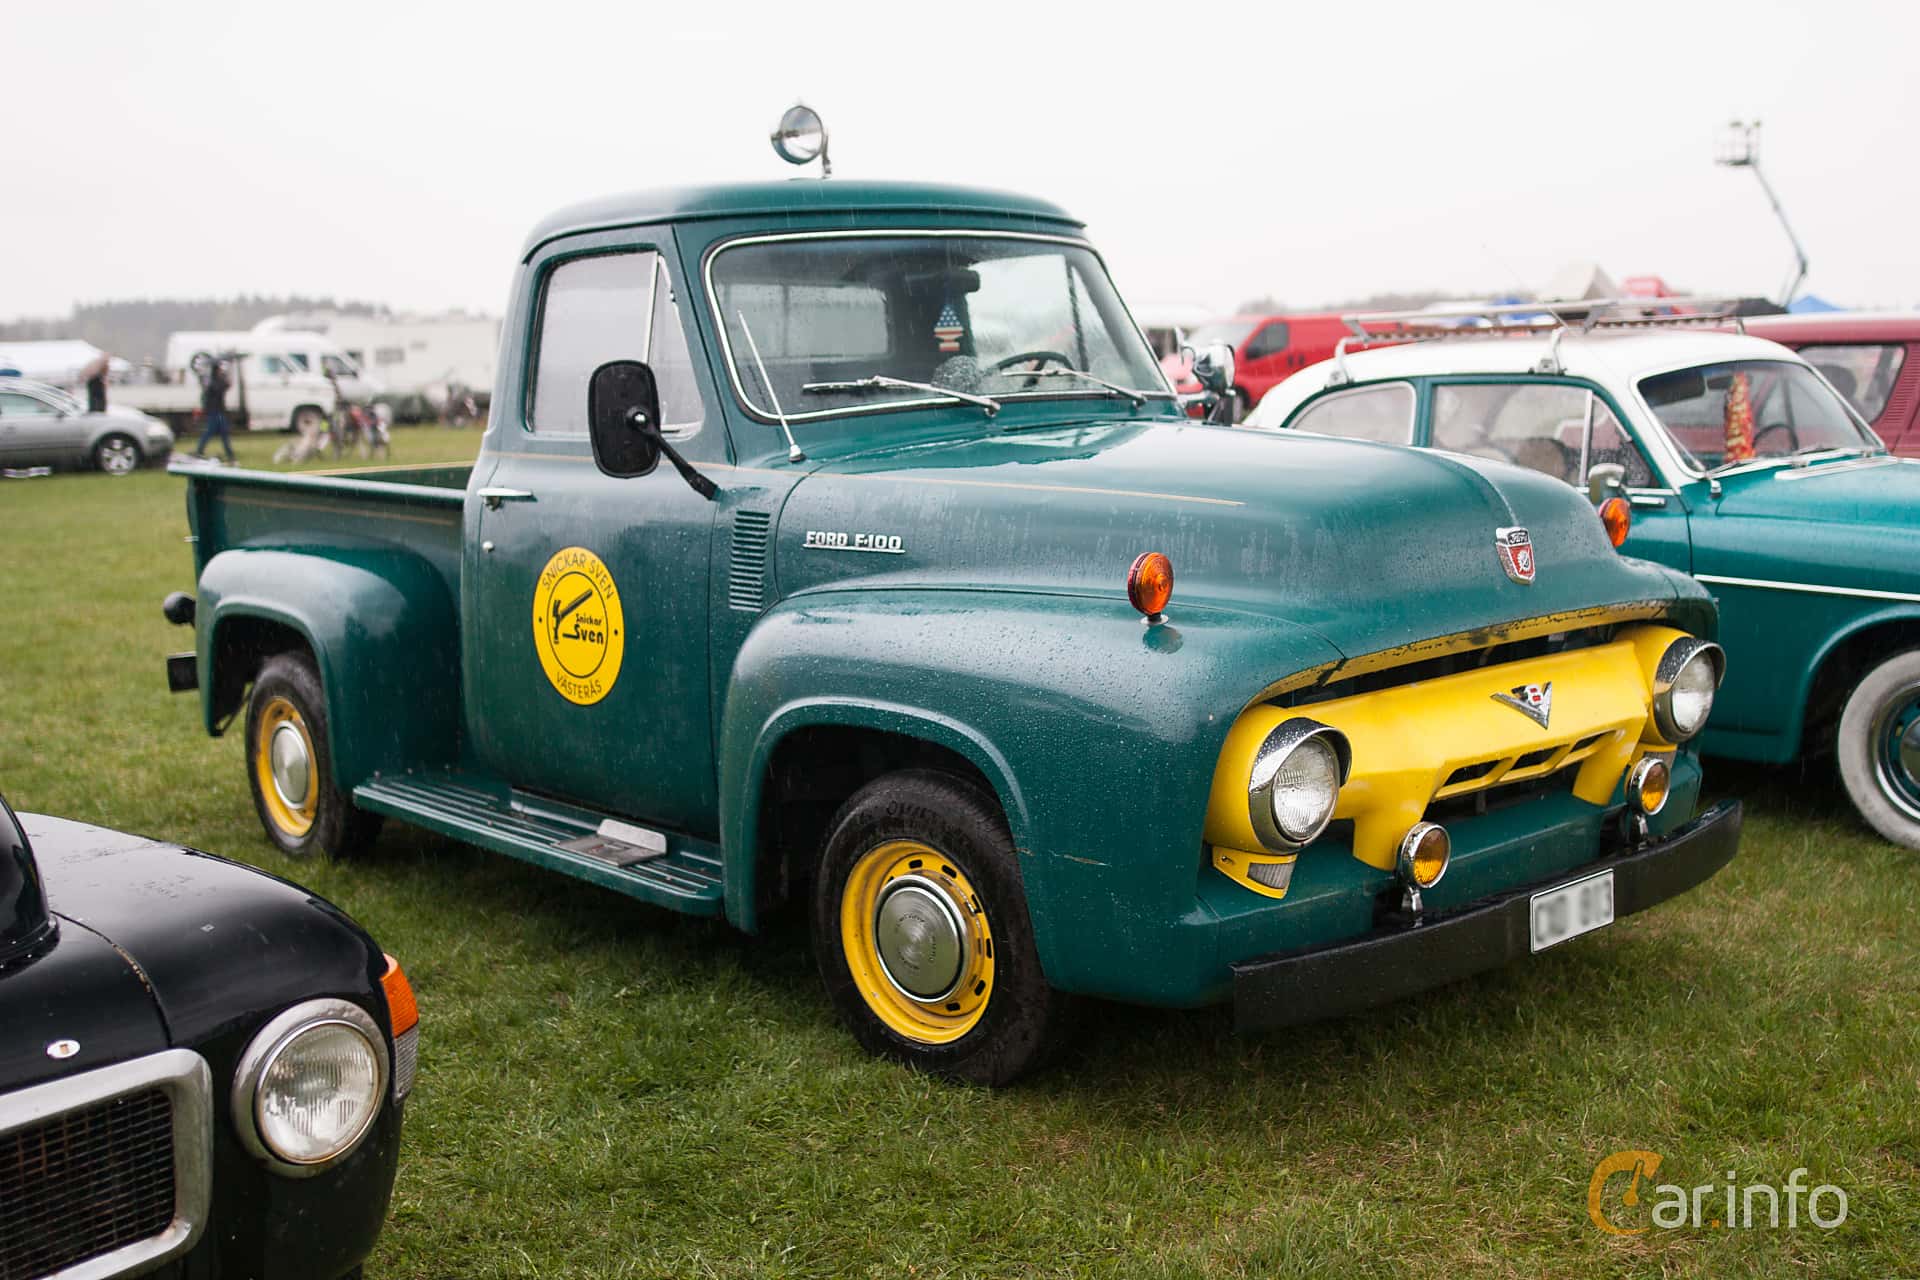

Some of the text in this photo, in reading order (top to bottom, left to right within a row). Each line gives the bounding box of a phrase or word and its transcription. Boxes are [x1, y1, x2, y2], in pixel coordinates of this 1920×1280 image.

[806, 531, 902, 549] FORD F-100
[542, 552, 614, 600] SNICKAR SVEN
[562, 624, 604, 645] Sven
